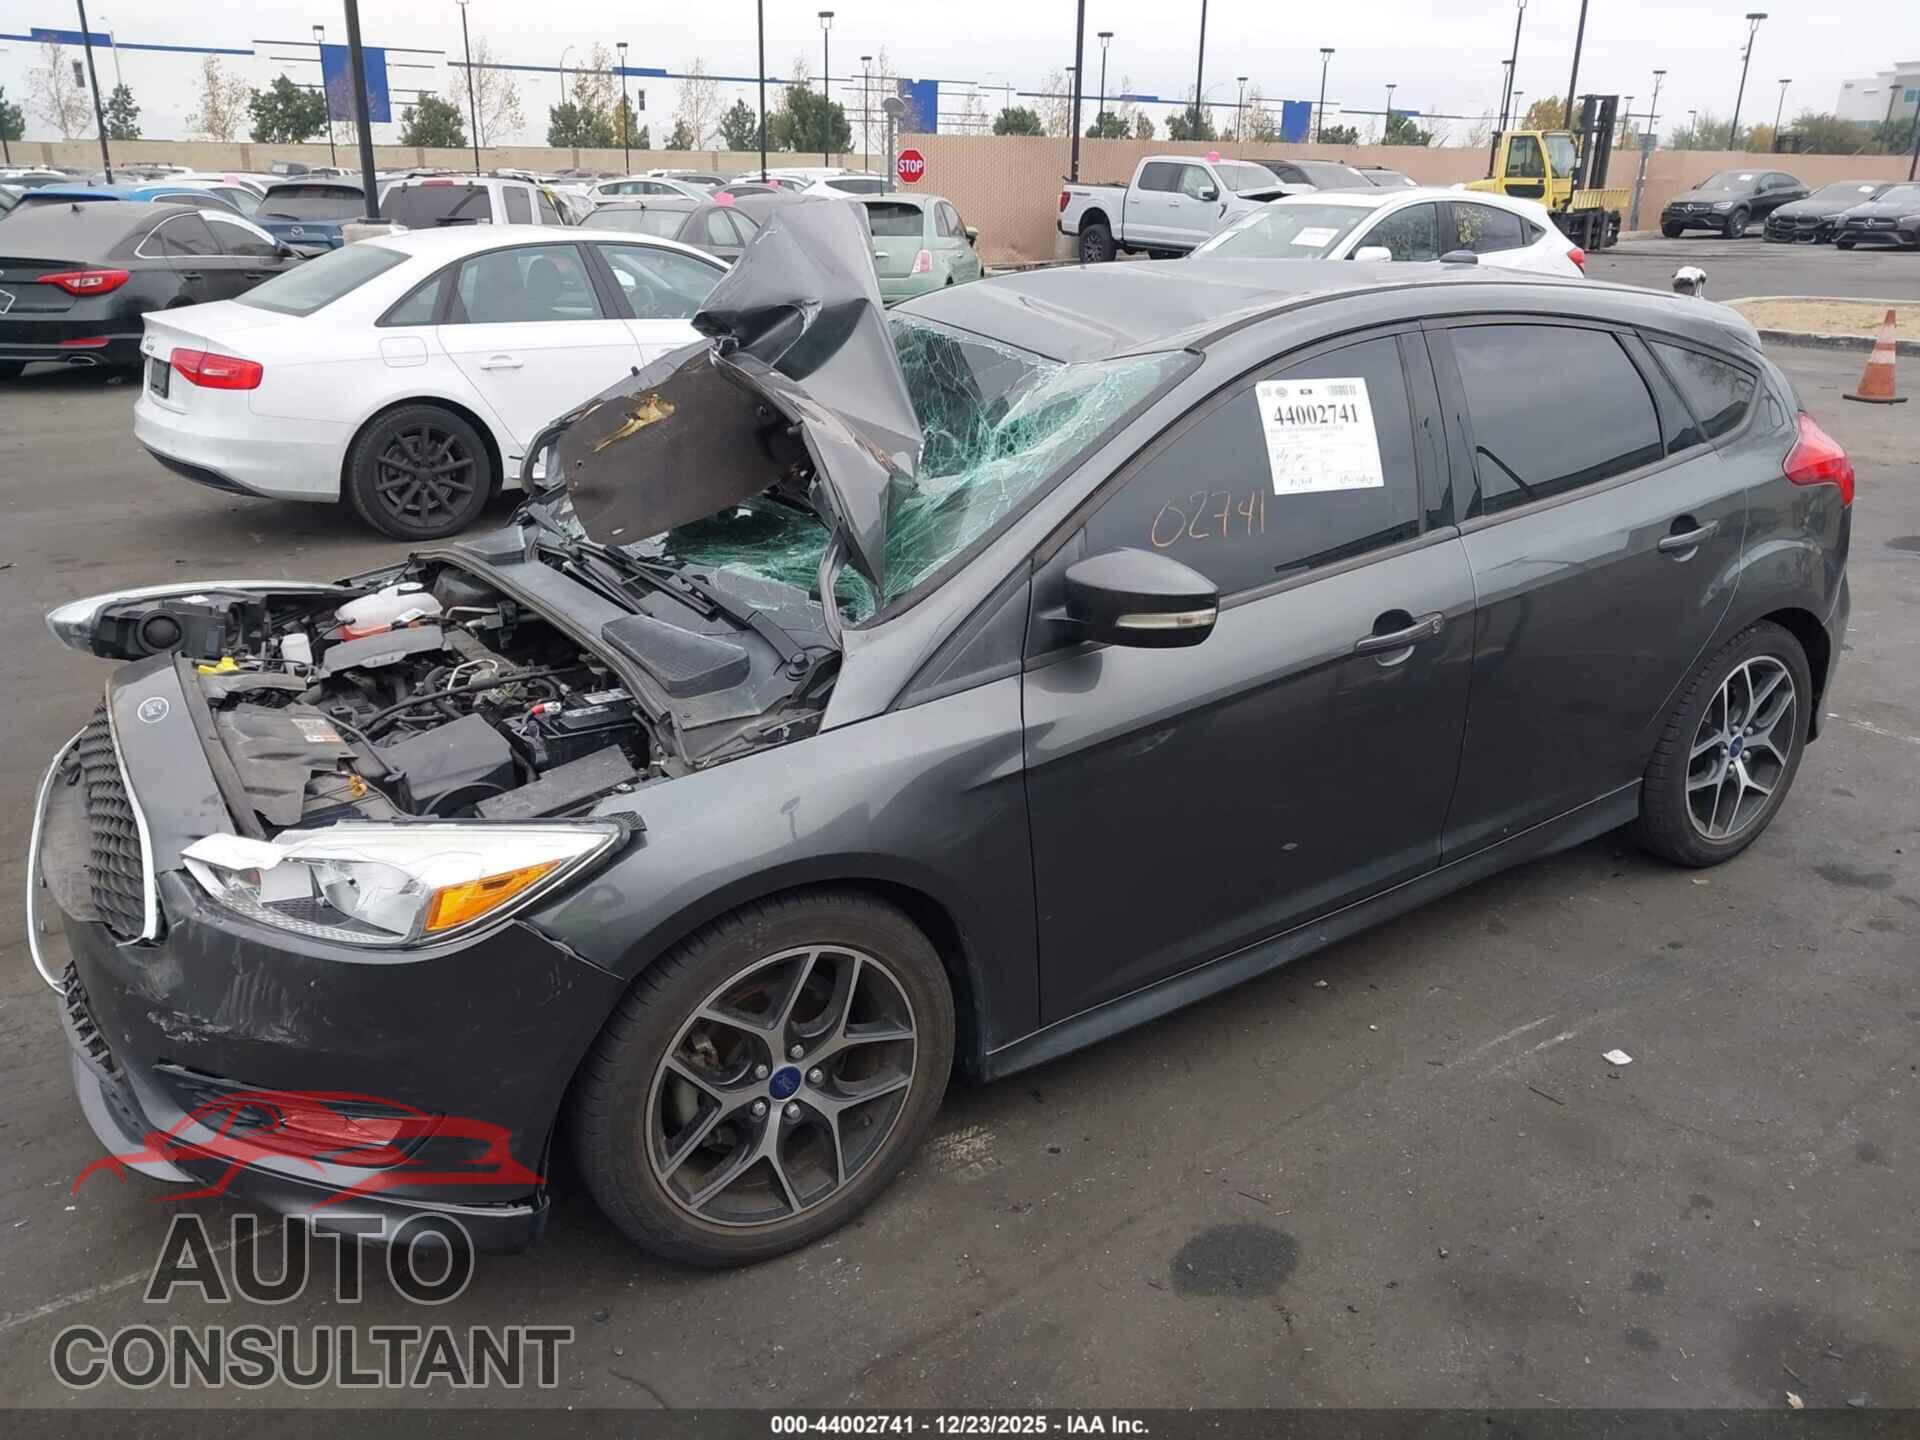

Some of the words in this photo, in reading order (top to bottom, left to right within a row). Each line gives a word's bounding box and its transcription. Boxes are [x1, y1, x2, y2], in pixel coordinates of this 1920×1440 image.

[898, 159, 923, 173] STOP
[1274, 403, 1359, 426] 44002741
[1151, 489, 1265, 547] 02741
